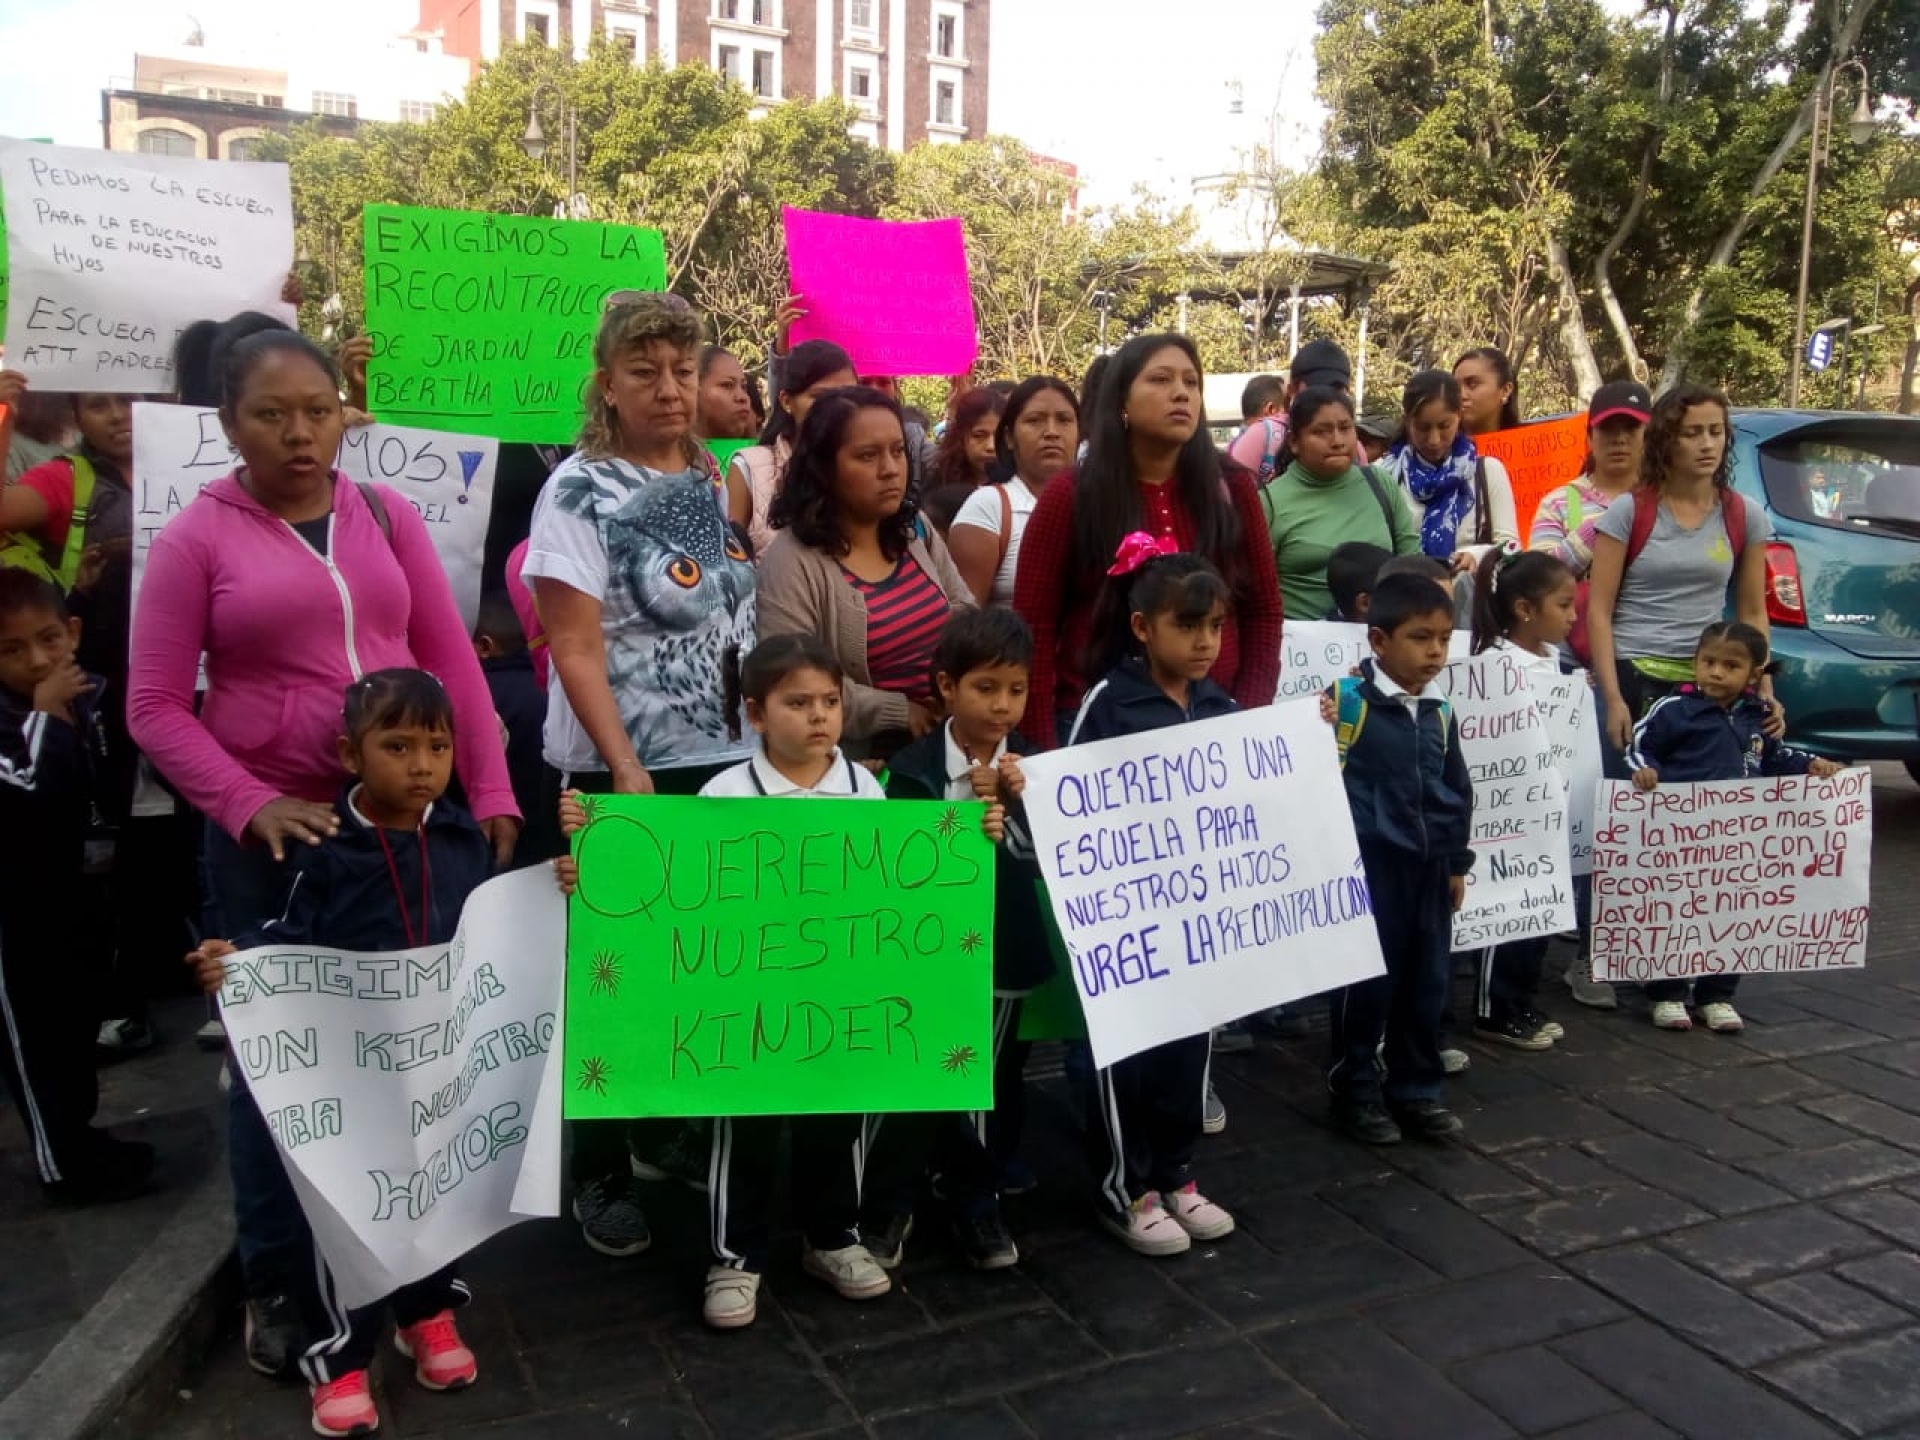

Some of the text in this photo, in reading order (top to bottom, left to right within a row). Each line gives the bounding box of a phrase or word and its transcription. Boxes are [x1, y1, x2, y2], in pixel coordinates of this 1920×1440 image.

[29, 157, 130, 191] PEDIMOS
[33, 198, 218, 247] PARA LA EDUCACION
[377, 215, 641, 260] EXIGIMOS LA
[92, 233, 223, 270] DE NUESTROS
[367, 330, 405, 361] DE
[371, 371, 492, 406] BERTHA
[514, 373, 560, 406] VON
[138, 477, 183, 514] LA
[1460, 705, 1540, 740] GLUMER
[1056, 734, 1294, 817] QUEREMOS UNA
[1491, 786, 1515, 809] DE
[1527, 782, 1553, 802] EL
[1651, 783, 1755, 819] pedimos
[1763, 776, 1798, 803] de
[1055, 803, 1260, 878] ESCUELA PARA
[1596, 817, 1630, 846] de
[1641, 818, 1665, 847] la
[1670, 813, 1768, 842] manera
[1776, 808, 1827, 829] mas
[1762, 834, 1815, 860] con
[1824, 829, 1848, 851] la
[577, 814, 980, 921] QUEREMOS
[1803, 851, 1843, 877] del
[1065, 843, 1291, 930] NUESTROS HIJOS
[1520, 882, 1567, 910] donde
[1680, 891, 1708, 919] de
[1715, 884, 1796, 913] niños
[672, 907, 945, 985] NUESTRO
[1183, 914, 1217, 965] LA
[1454, 909, 1558, 946] ESTUDIAR
[1593, 906, 1870, 954] BERTHA VON GLUMER
[222, 922, 467, 1007] EXIGIM
[241, 1027, 319, 1081] UN
[671, 996, 920, 1081] KINDER
[368, 1101, 529, 1222] HIJOS
